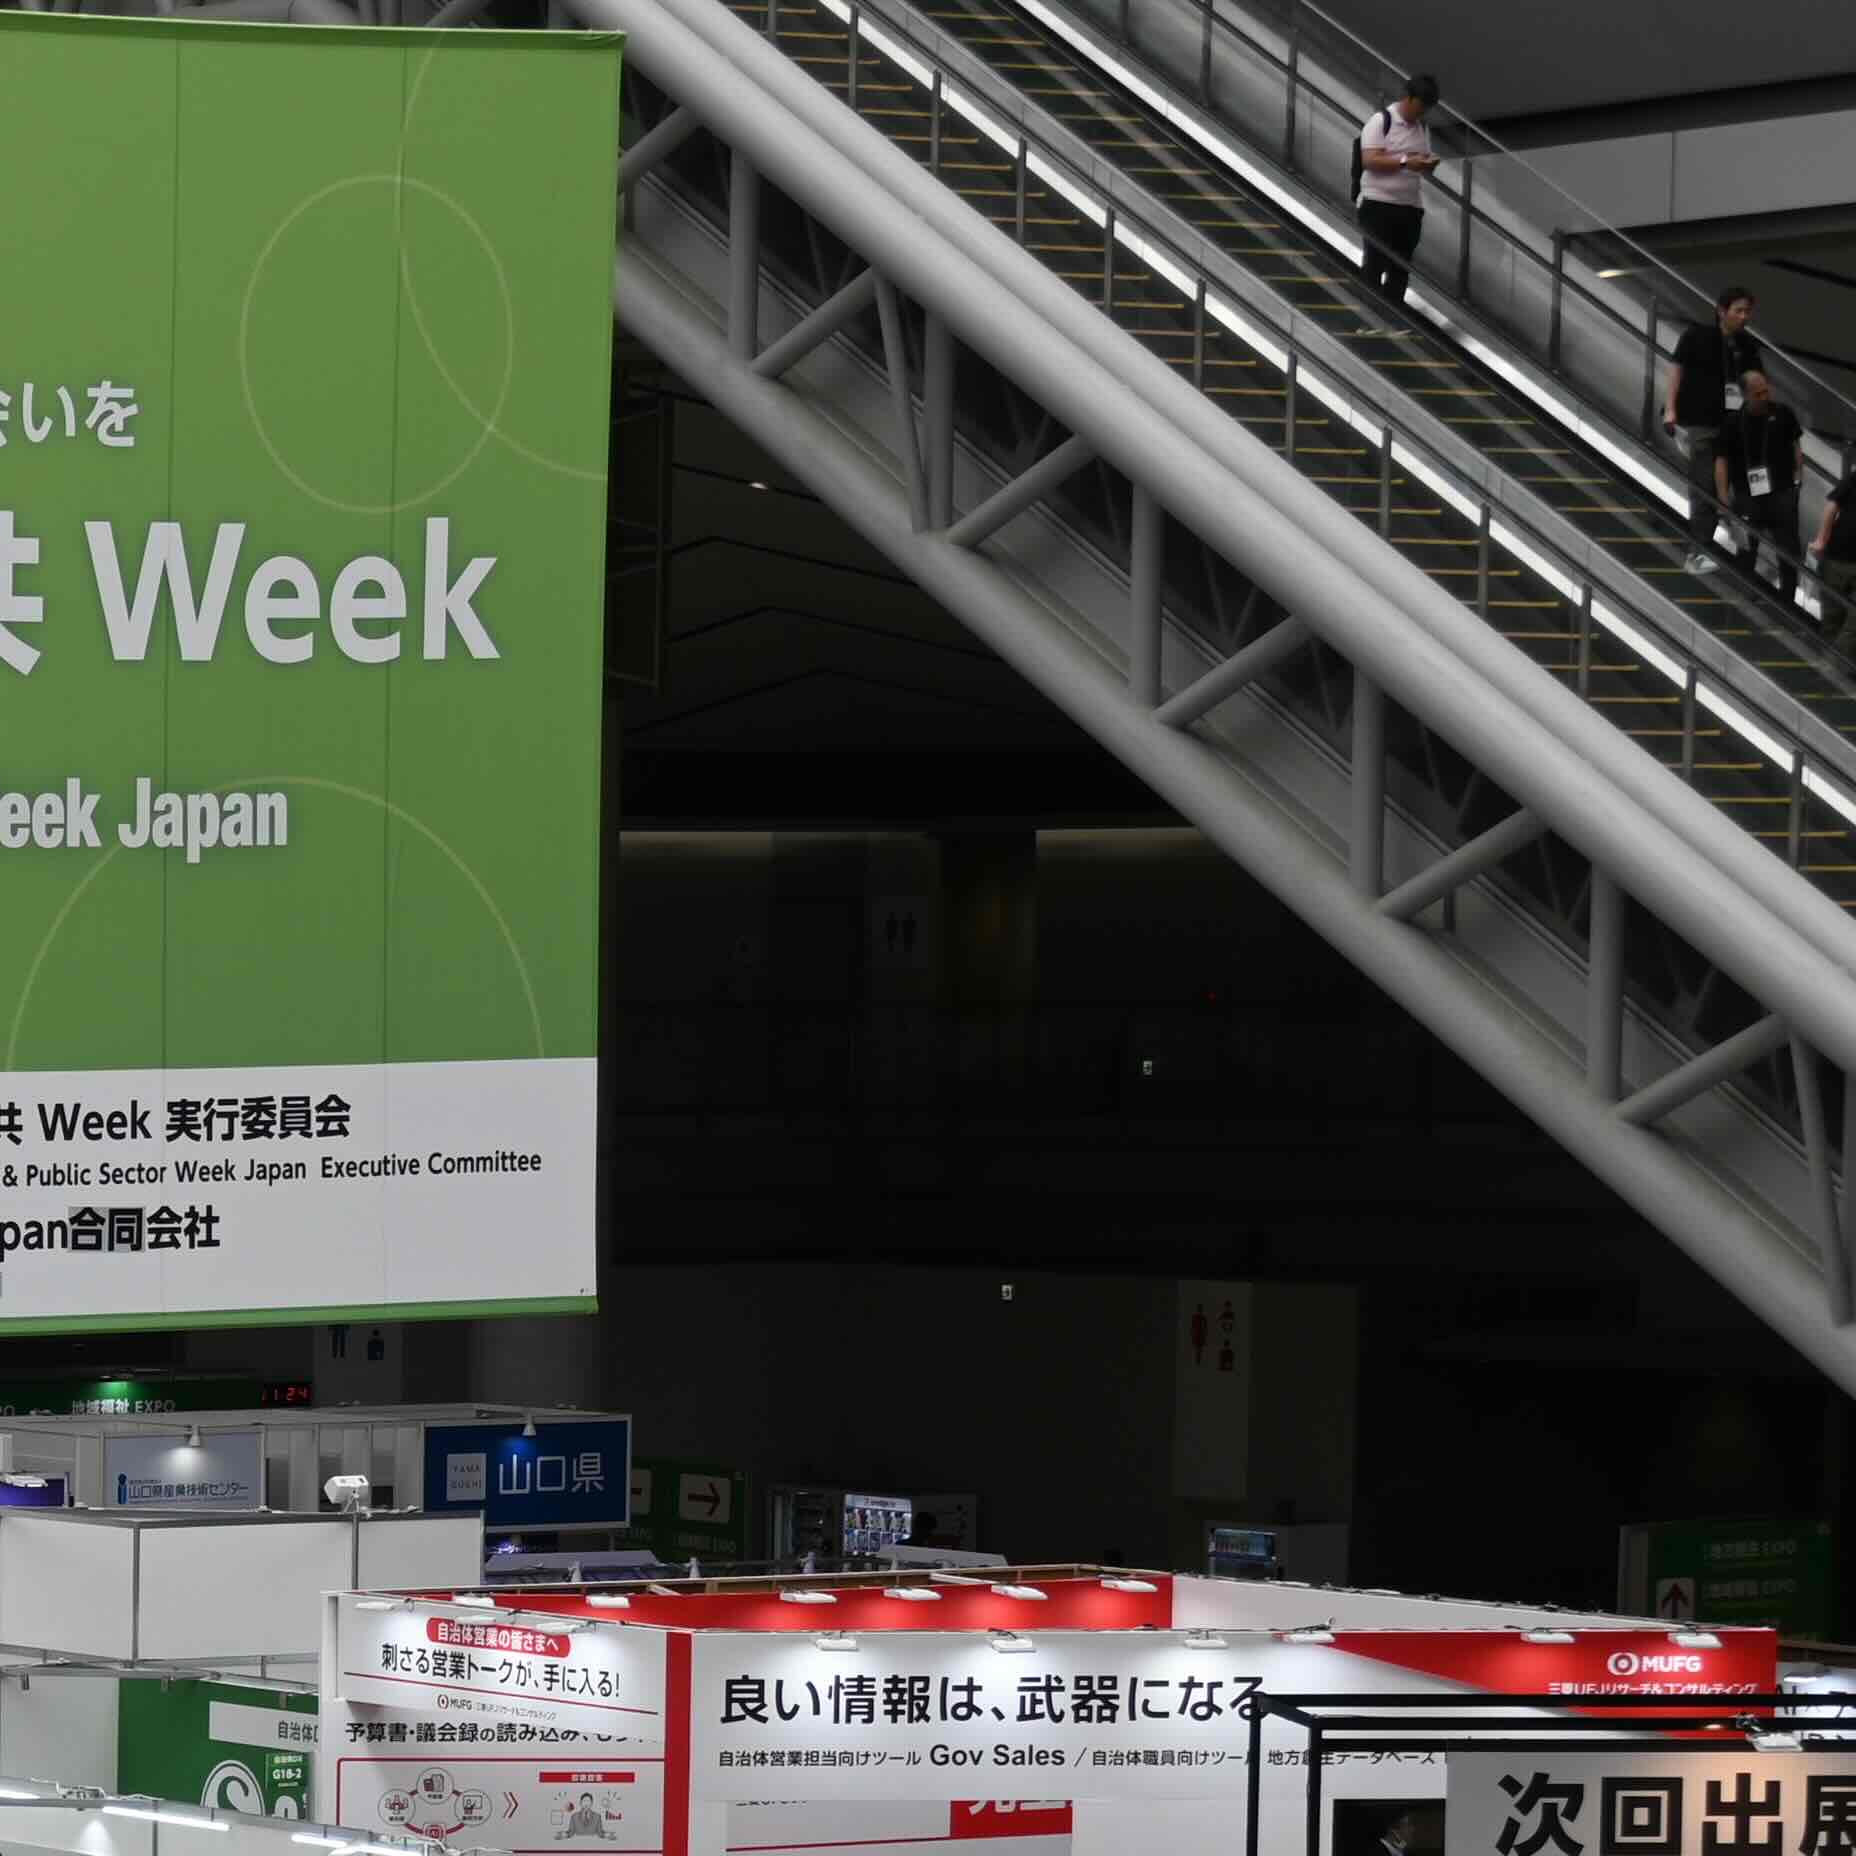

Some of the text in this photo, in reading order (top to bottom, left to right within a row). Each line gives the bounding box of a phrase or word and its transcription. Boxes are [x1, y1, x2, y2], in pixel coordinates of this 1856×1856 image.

[85, 515, 501, 665] Week
[117, 776, 289, 862] Japan
[39, 1101, 152, 1143] Week
[166, 1095, 352, 1143] 実行委員会
[1, 1163, 20, 1188] &
[27, 1160, 92, 1189] Public
[99, 1158, 168, 1186] Sector
[175, 1157, 239, 1184] Week
[244, 1156, 308, 1188] Japan
[321, 1153, 421, 1181] Executive
[428, 1148, 544, 1177] Committee
[498, 1452, 605, 1495] 山口県
[437, 1621, 560, 1654] 自治体営業の皆さまへ
[380, 1643, 622, 1698] 刺さる営業トークが、手に入る！
[1641, 1655, 1703, 1673] MUFG
[719, 1675, 1268, 1726] 良い情報は、武器になる
[719, 1748, 922, 1769] 自治体営業担当向けツール
[929, 1743, 985, 1769] Gov
[992, 1742, 1066, 1767] Sales
